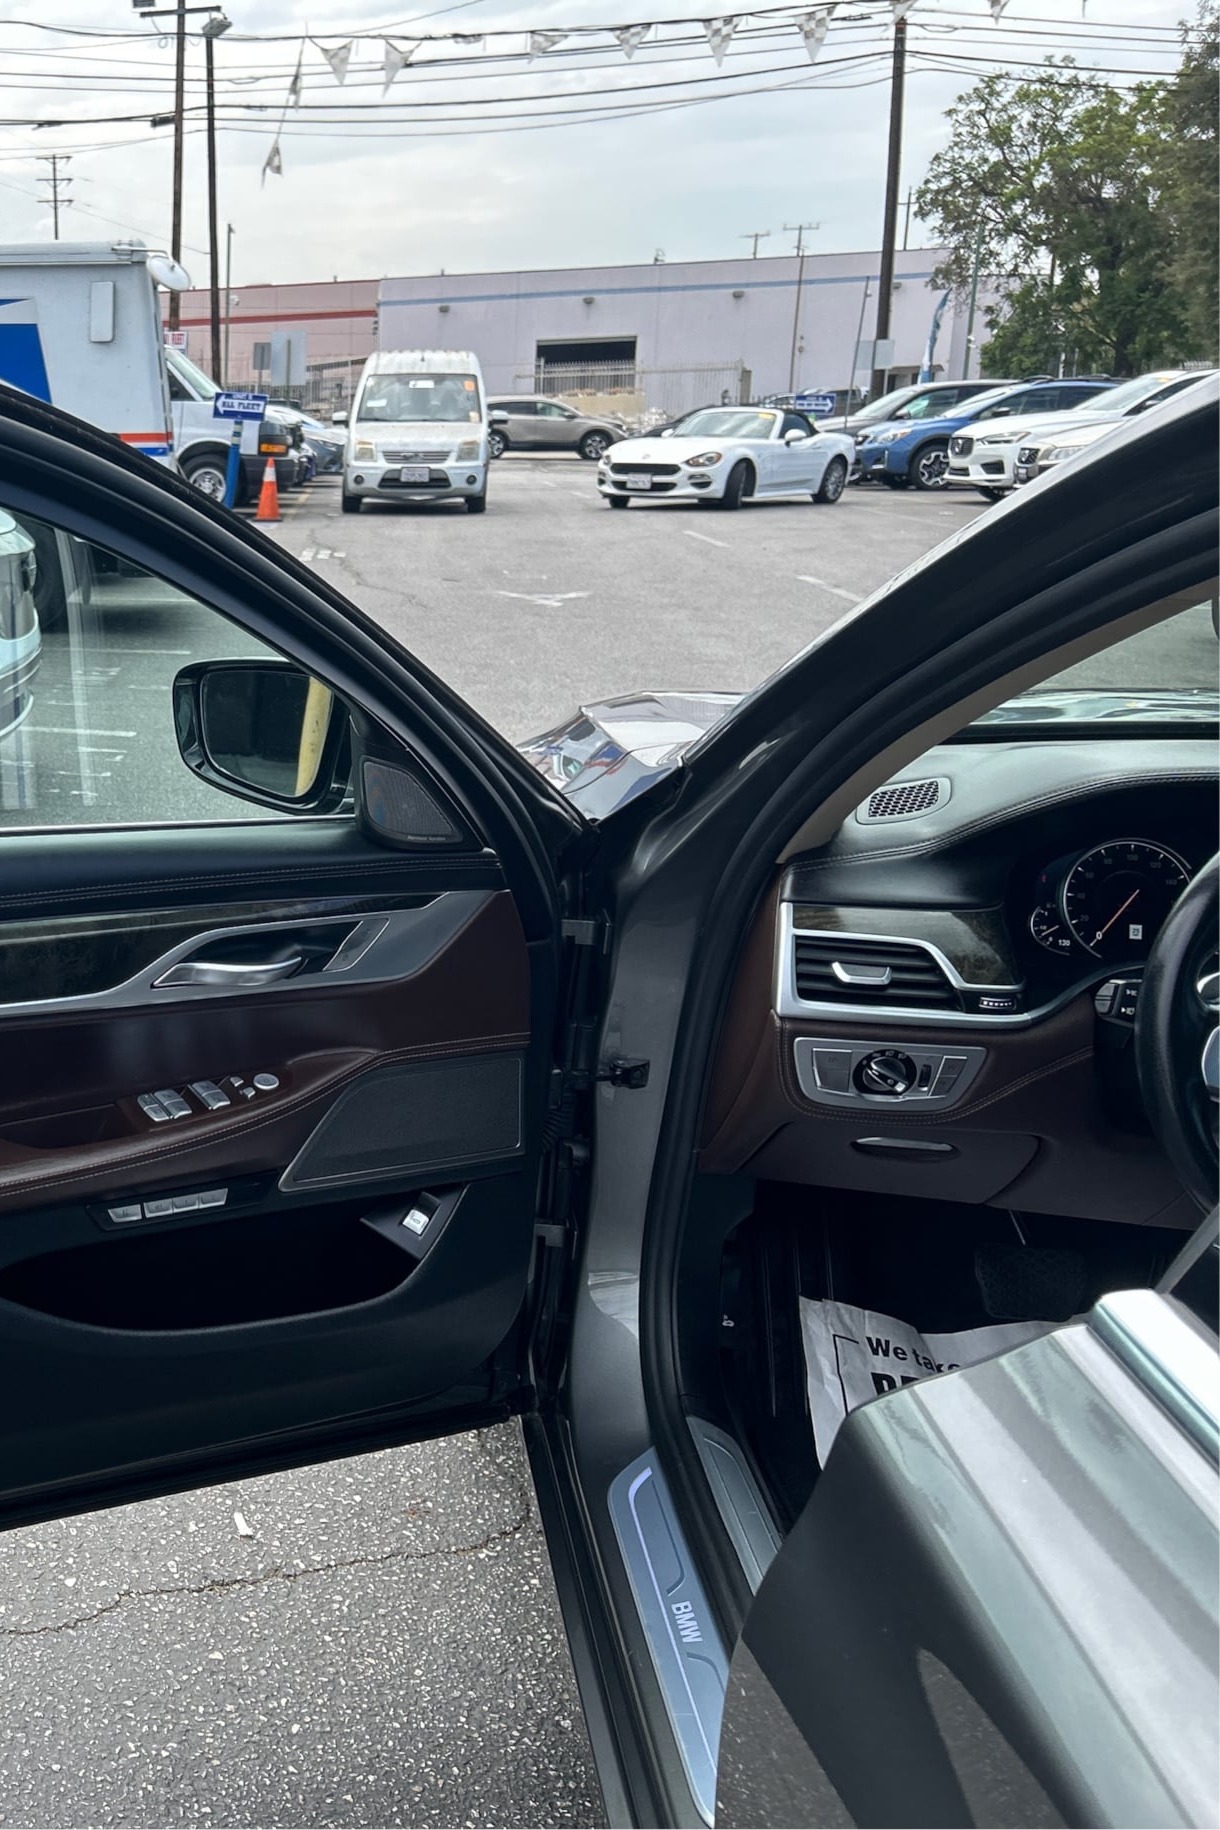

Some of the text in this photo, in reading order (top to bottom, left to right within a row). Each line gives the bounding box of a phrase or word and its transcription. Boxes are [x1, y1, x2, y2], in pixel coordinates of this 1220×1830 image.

[237, 402, 261, 411] FLEET
[866, 1336, 908, 1361] We
[671, 1600, 703, 1643] BMW
